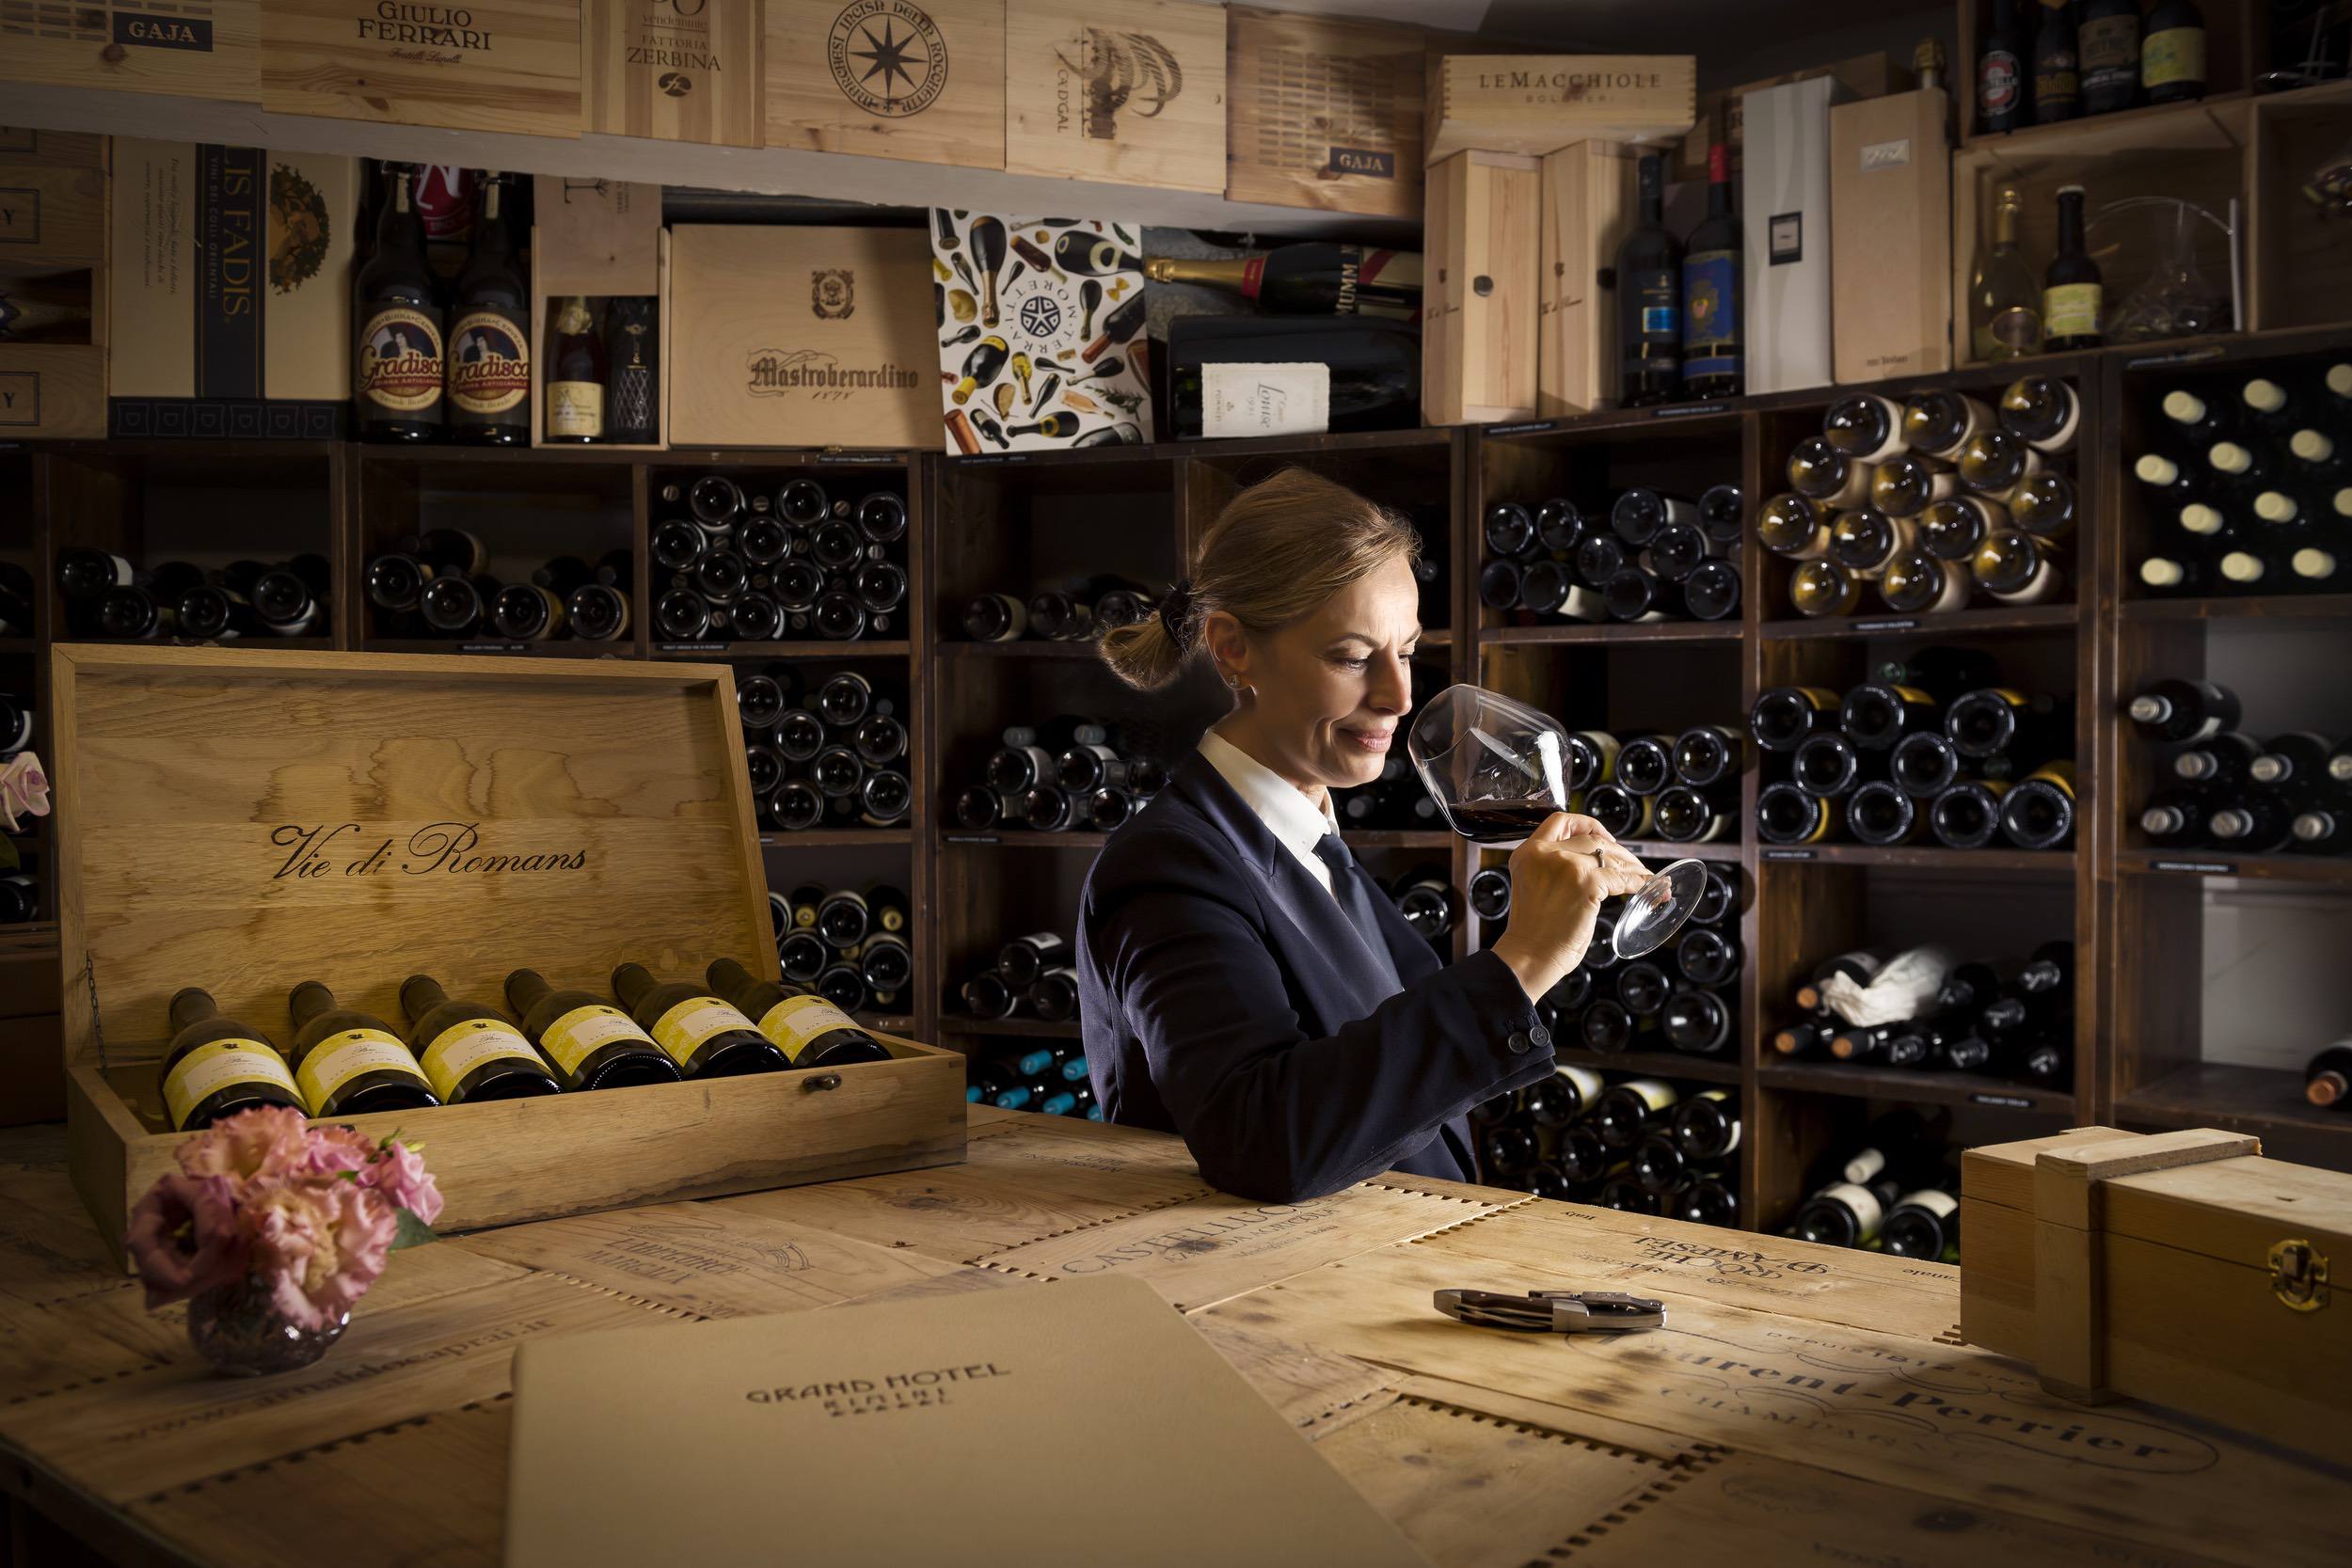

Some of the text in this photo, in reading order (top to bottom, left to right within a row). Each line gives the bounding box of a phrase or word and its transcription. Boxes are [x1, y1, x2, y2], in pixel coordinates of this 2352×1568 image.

[377, 1, 471, 27] GIULIO
[127, 21, 197, 43] GAJA
[358, 18, 492, 50] FERRARI
[642, 34, 707, 50] FATTORIA
[627, 47, 721, 71] ZERBINA
[1339, 152, 1386, 172] GAJA
[222, 151, 253, 317] IS FADIS
[750, 357, 919, 388] Mastroberardino
[1257, 382, 1288, 429] Louise
[270, 822, 587, 879] Vie di Romans
[746, 1363, 1012, 1404] GRAND HOTEL
[1597, 1332, 2170, 1460] urent-Perrier
